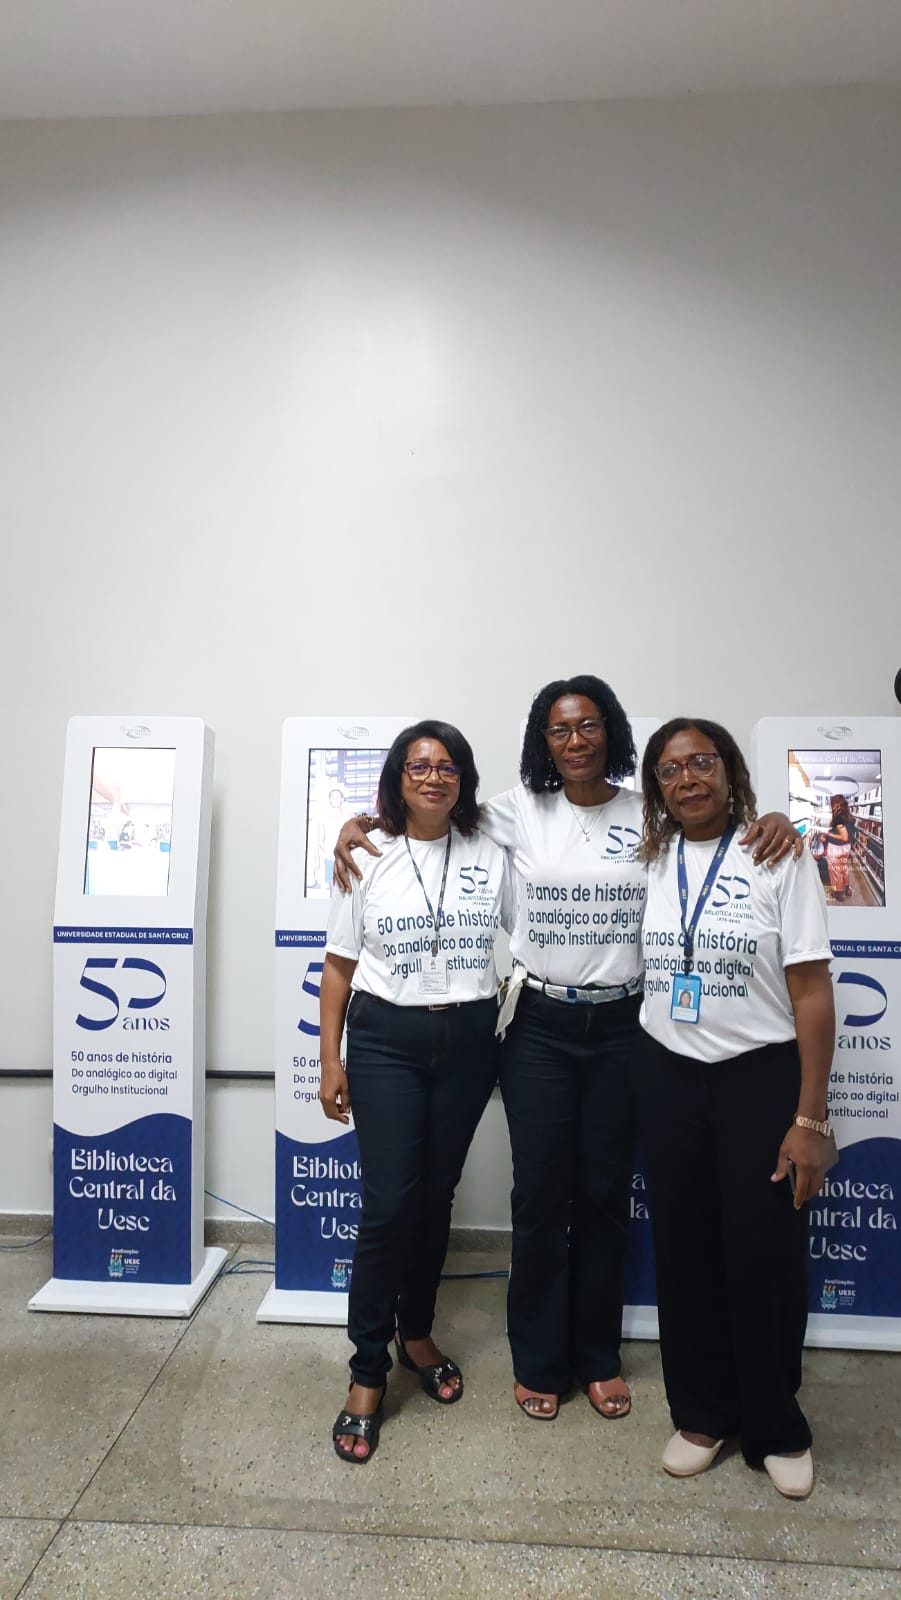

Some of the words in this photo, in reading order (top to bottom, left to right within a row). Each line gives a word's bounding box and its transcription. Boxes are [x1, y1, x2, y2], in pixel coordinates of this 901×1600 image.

[606, 825, 642, 854] 50
[460, 865, 489, 894] 50
[536, 886, 568, 901] anos
[572, 884, 590, 902] de
[594, 882, 646, 902] história
[712, 874, 750, 908] 50
[377, 916, 393, 935] 50
[396, 915, 433, 932] anos
[536, 908, 590, 930] analógico
[592, 913, 608, 924] ao
[458, 937, 474, 949] ao
[528, 929, 566, 948] Orgulho
[568, 930, 638, 946] Institucional
[646, 932, 674, 946] anos
[698, 928, 758, 955] história
[698, 960, 712, 973] ao
[714, 958, 754, 980] digital
[76, 958, 166, 1031] 50
[122, 1017, 170, 1031] anos
[838, 1034, 892, 1050] anos
[71, 1051, 84, 1062] 50
[86, 1054, 113, 1062] anos
[116, 1052, 130, 1062] de
[132, 1052, 172, 1064] história
[293, 1056, 306, 1068] 50
[72, 1068, 84, 1078] Do
[86, 1068, 132, 1081] analógico
[134, 1070, 146, 1079] ao
[148, 1069, 178, 1082] digital
[294, 1074, 306, 1084] Do
[830, 1072, 845, 1083] de
[848, 1072, 894, 1085] história
[72, 1084, 109, 1096] Orgulho
[111, 1085, 168, 1096] Institucional
[294, 1090, 320, 1102] Orgul
[850, 1092, 864, 1101] ao
[866, 1090, 899, 1104] digital
[828, 1106, 888, 1118] nstitucional
[71, 1148, 174, 1172] Biblioteca
[292, 1156, 362, 1179] Bibliot
[69, 1176, 144, 1200] Central
[150, 1179, 176, 1201] da
[290, 1184, 362, 1208] Centra
[819, 1177, 894, 1200] ioteca
[98, 1208, 150, 1231] Uesc
[320, 1216, 358, 1240] Ues
[809, 1206, 860, 1228] ntral
[868, 1206, 897, 1230] da
[810, 1236, 866, 1261] Uesc
